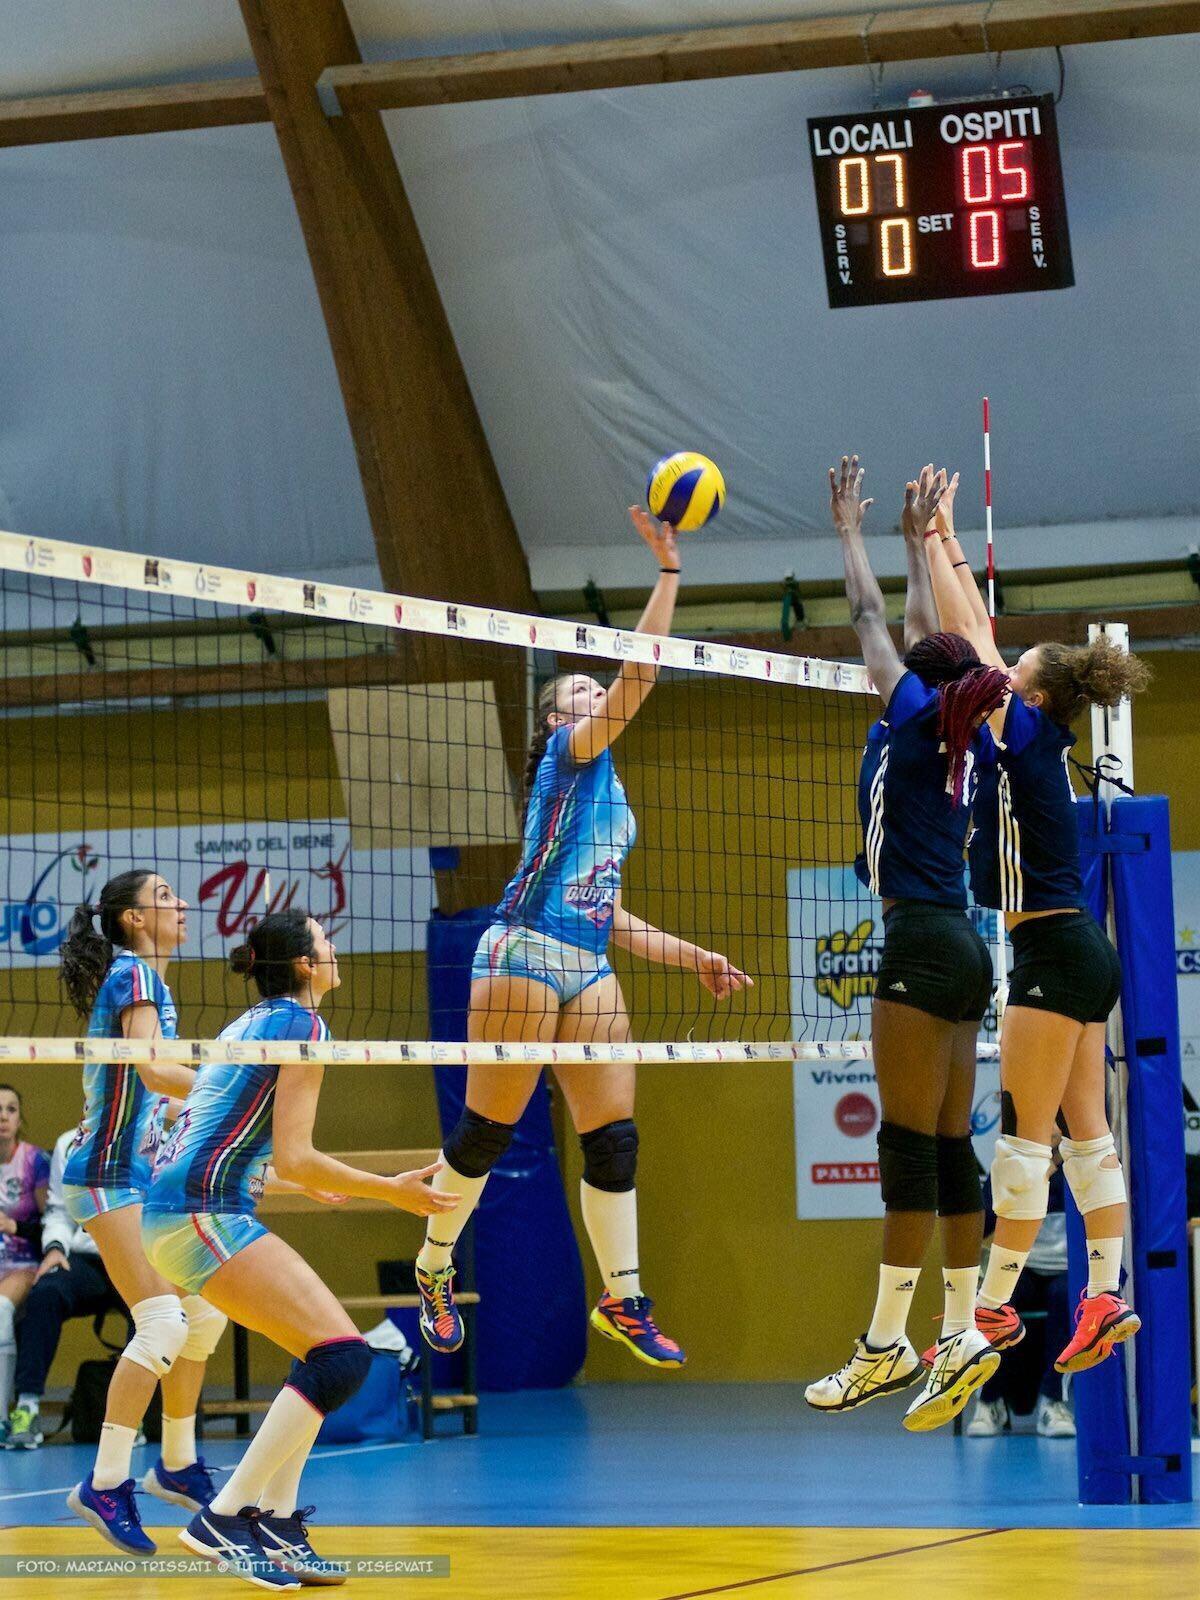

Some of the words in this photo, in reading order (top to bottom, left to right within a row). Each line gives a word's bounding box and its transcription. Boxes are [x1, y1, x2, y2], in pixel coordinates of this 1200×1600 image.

[814, 119, 913, 156] LOCALI
[940, 107, 1041, 144] OSPITI
[839, 154, 904, 215] 07
[963, 143, 1027, 203] 05
[918, 213, 954, 233] SET
[970, 211, 1000, 268] 0
[881, 218, 911, 276] 0
[195, 838, 251, 855] SAVINO
[256, 837, 287, 851] DEL
[293, 834, 335, 850] BENE
